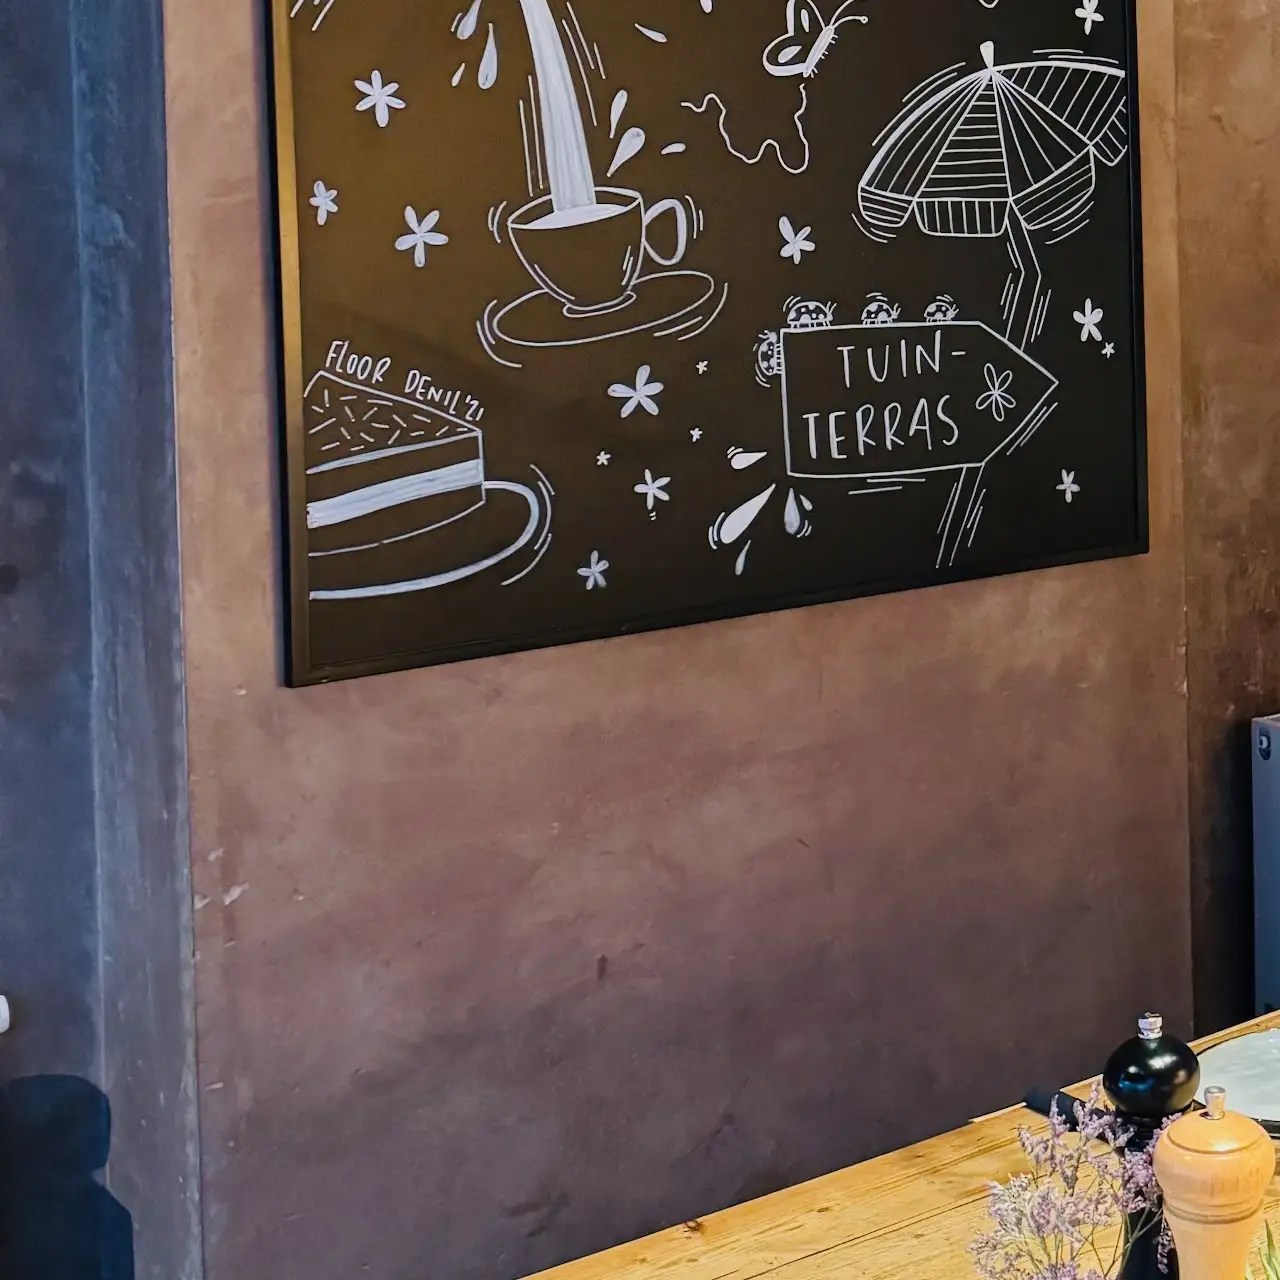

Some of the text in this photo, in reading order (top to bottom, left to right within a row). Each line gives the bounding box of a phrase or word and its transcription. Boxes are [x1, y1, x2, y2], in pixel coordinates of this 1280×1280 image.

[326, 340, 391, 384] FLOOR
[837, 330, 966, 388] TUIN-
[803, 395, 959, 459] TERRAS
